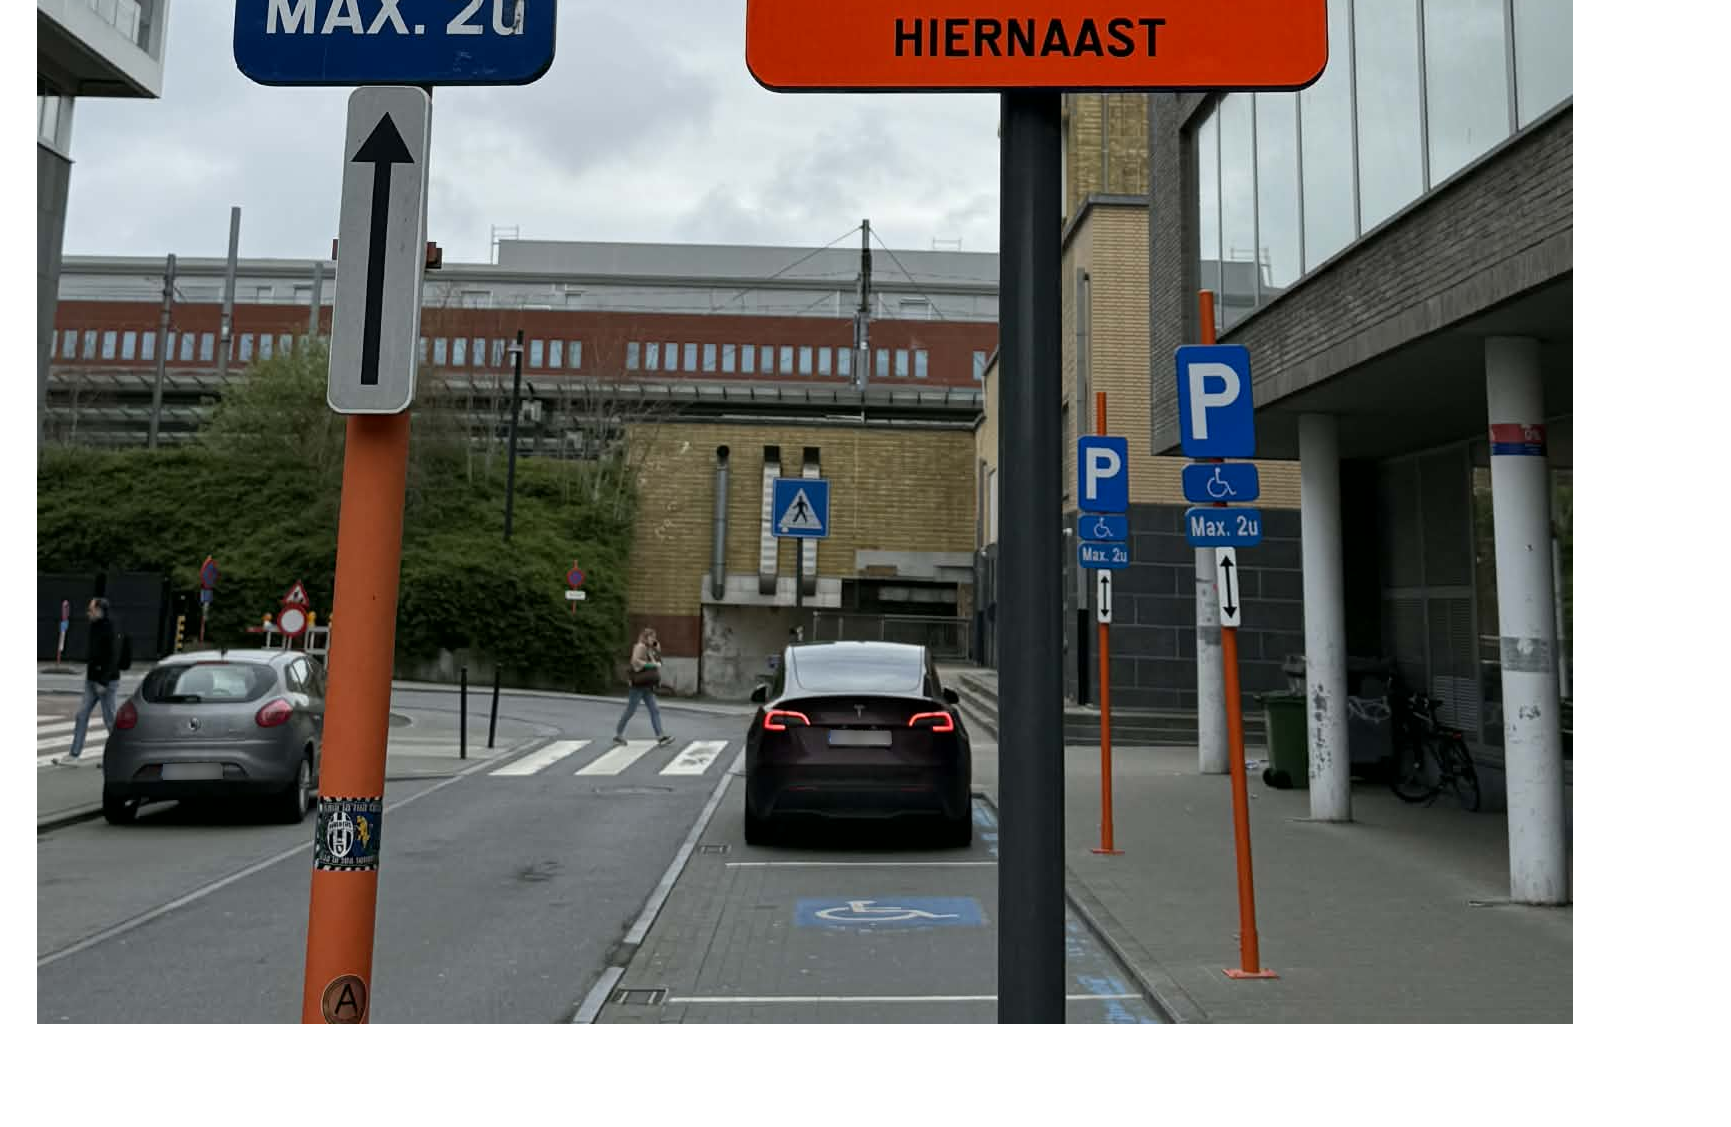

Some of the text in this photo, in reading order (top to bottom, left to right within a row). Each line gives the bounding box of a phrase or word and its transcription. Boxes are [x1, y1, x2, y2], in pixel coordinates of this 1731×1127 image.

[895, 18, 1166, 57] HIERNAAST
[1188, 362, 1241, 440] P
[1086, 447, 1121, 500] P
[1191, 515, 1259, 537] Max. 2u
[1082, 547, 1128, 563] Max. 2u
[335, 983, 358, 1015] A
